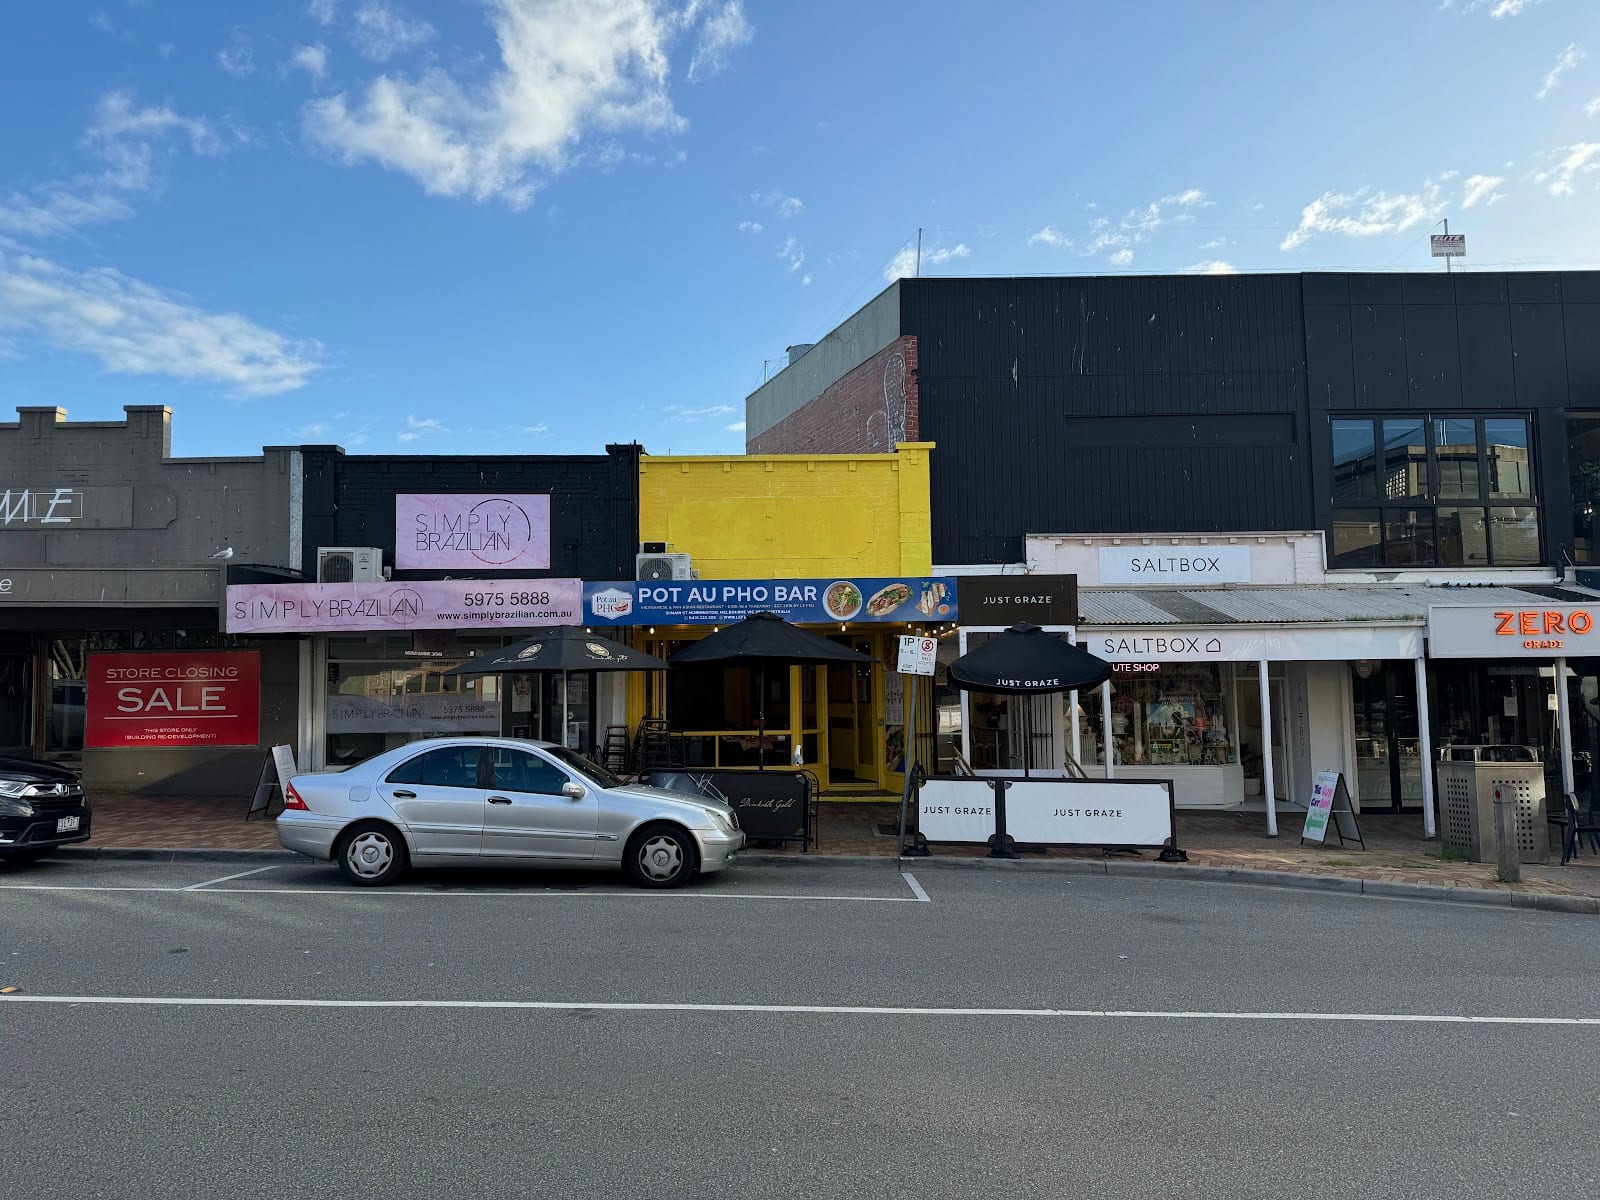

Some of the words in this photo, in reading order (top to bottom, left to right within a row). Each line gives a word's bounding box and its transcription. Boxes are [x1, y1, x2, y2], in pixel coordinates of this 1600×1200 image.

[415, 513, 511, 532] SIMPLY
[415, 532, 510, 551] BRAZILIAN
[1130, 557, 1220, 573] SALTBOX
[464, 592, 505, 607] 5975
[510, 591, 550, 606] 5888
[638, 587, 682, 603] POT
[687, 586, 717, 603] AU
[723, 586, 768, 602] PHO
[774, 586, 817, 601] BAR
[982, 596, 1010, 604] JUST
[1014, 595, 1053, 604] GRAZE
[234, 599, 324, 620] SIMPLY
[329, 598, 419, 618] BRAZILIAN
[437, 609, 572, 621] www.simplybrazilian.com.au
[1494, 610, 1594, 635] ZERO
[904, 637, 915, 647] 1P
[1104, 637, 1200, 654] SALTBOX
[1523, 640, 1564, 649] GRADI
[106, 668, 161, 679] STORE
[164, 666, 239, 678] CLOSING
[1133, 663, 1160, 672] SHOP
[995, 678, 1021, 687] JUST
[1024, 678, 1060, 687] GRAZE
[116, 686, 226, 712] SALE
[332, 708, 375, 719] SIMPLY
[443, 705, 463, 714] 5975
[465, 705, 485, 713] 5888
[923, 806, 950, 814] JUST
[954, 807, 992, 815] GRAZE
[1053, 809, 1081, 817] JUST
[1085, 809, 1123, 818] GRAZE
